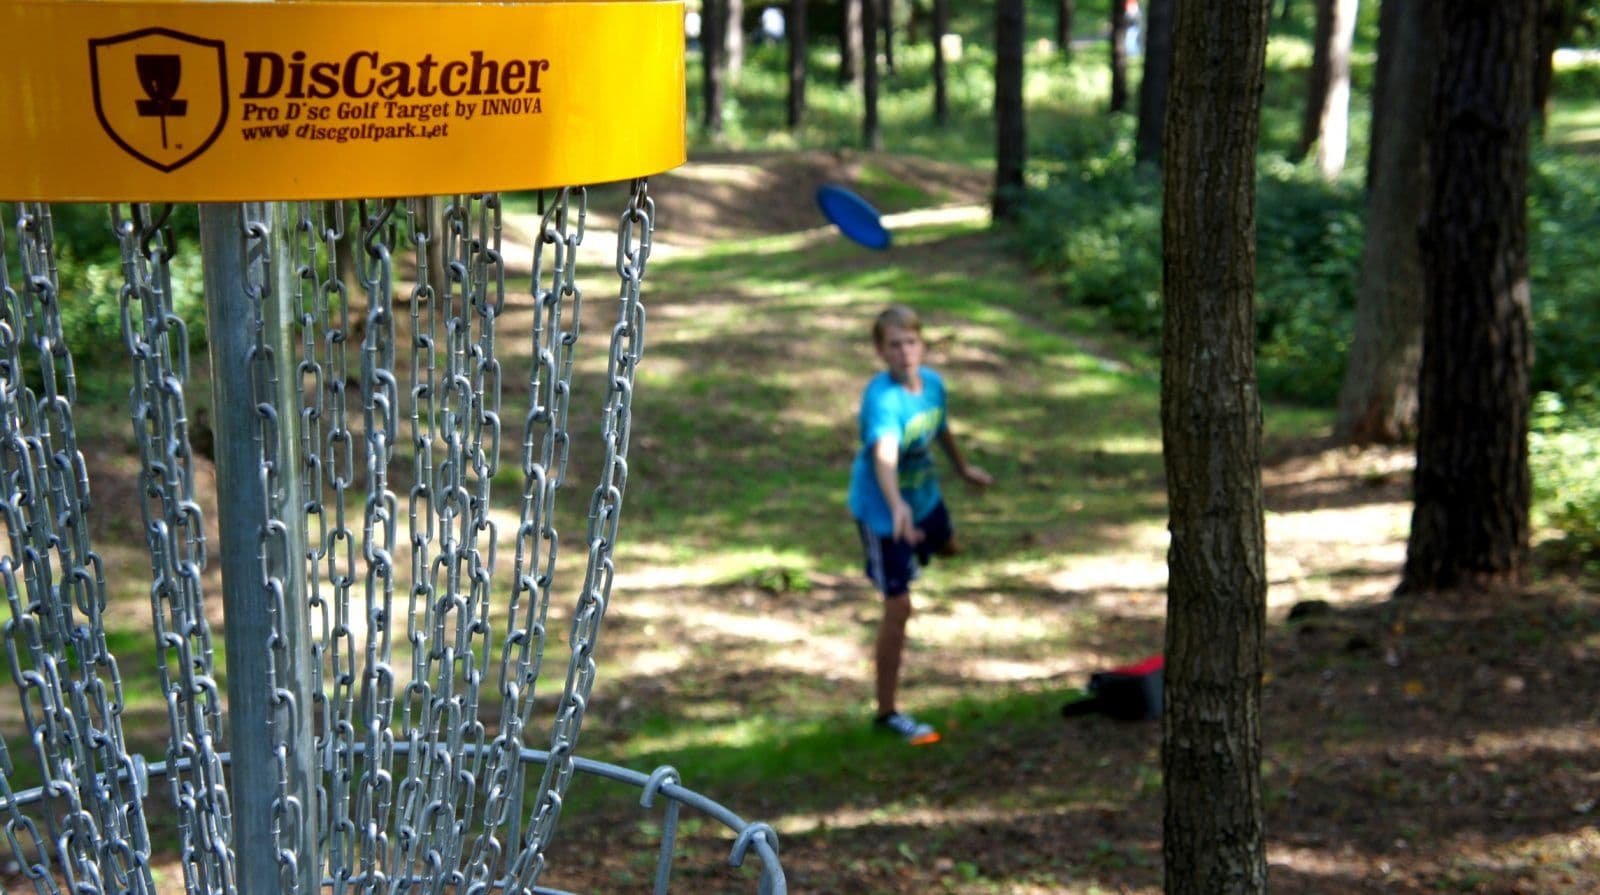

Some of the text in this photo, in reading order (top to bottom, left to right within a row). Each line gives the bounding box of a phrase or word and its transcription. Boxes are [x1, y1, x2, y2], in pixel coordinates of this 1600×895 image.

[239, 51, 549, 98] DisCatcher
[242, 97, 542, 121] Pro Dsc Golf Target by INNOVA
